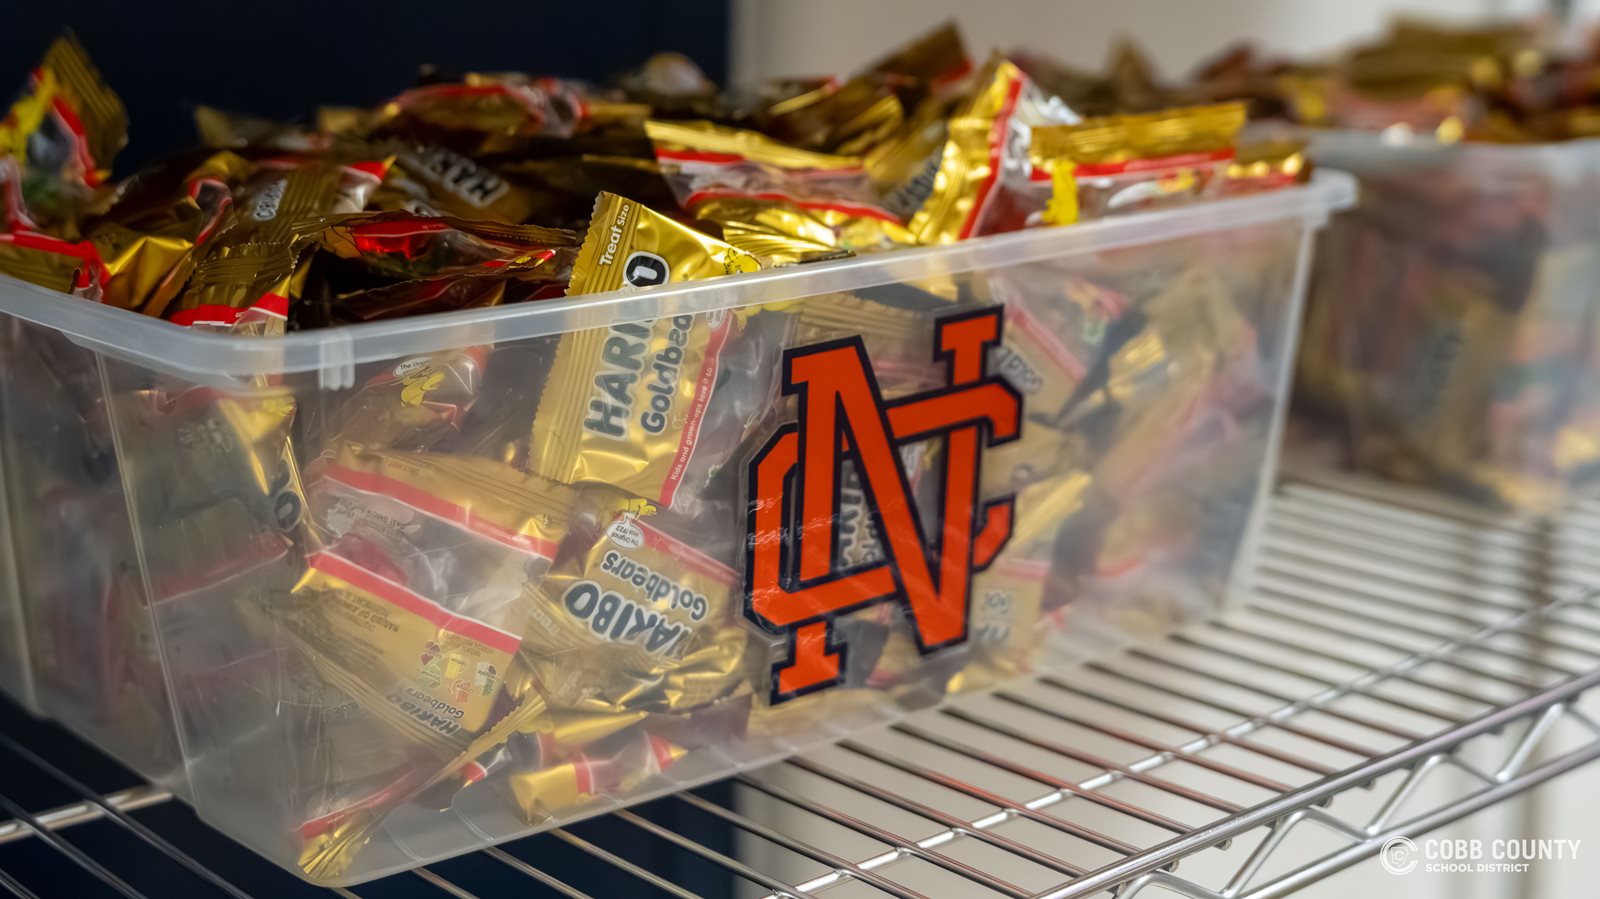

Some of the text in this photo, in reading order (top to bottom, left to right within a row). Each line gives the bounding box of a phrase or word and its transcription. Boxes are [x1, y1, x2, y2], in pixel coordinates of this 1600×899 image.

[600, 204, 630, 266] Treat Size
[671, 463, 683, 481] Kids
[681, 446, 690, 463] and
[686, 403, 702, 446] grown-ups
[699, 384, 708, 403] love
[602, 552, 707, 621] Goldbears
